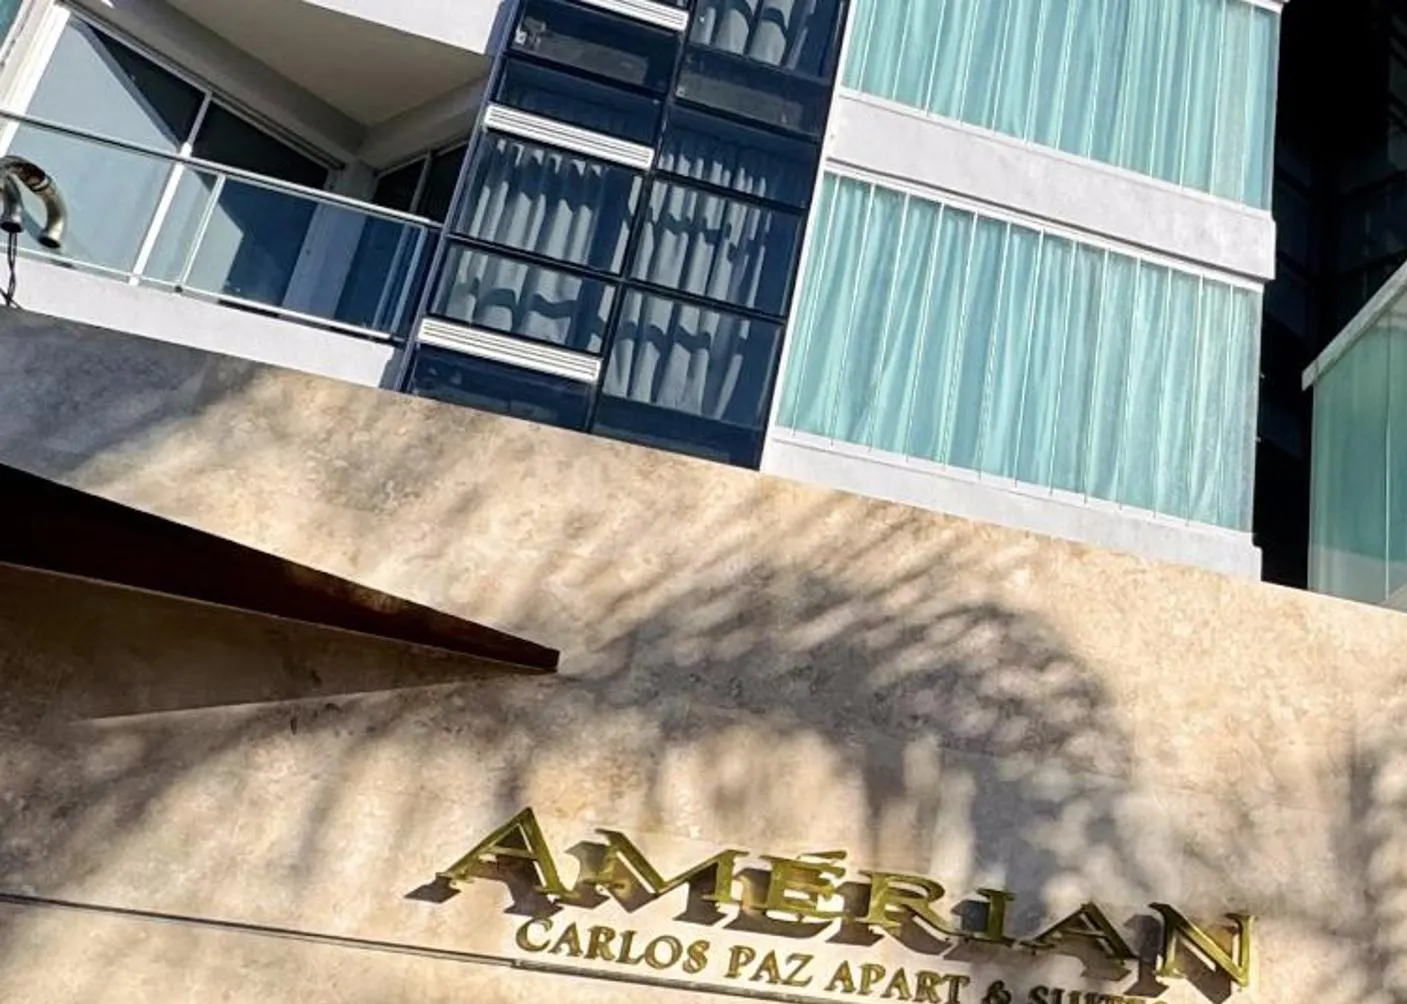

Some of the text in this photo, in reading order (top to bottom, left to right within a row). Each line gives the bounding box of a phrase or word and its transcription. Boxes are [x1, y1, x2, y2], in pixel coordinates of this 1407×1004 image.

[434, 807, 1257, 989] AMÉRIAN
[515, 916, 710, 975] CARLOS
[724, 945, 815, 987] PAZ
